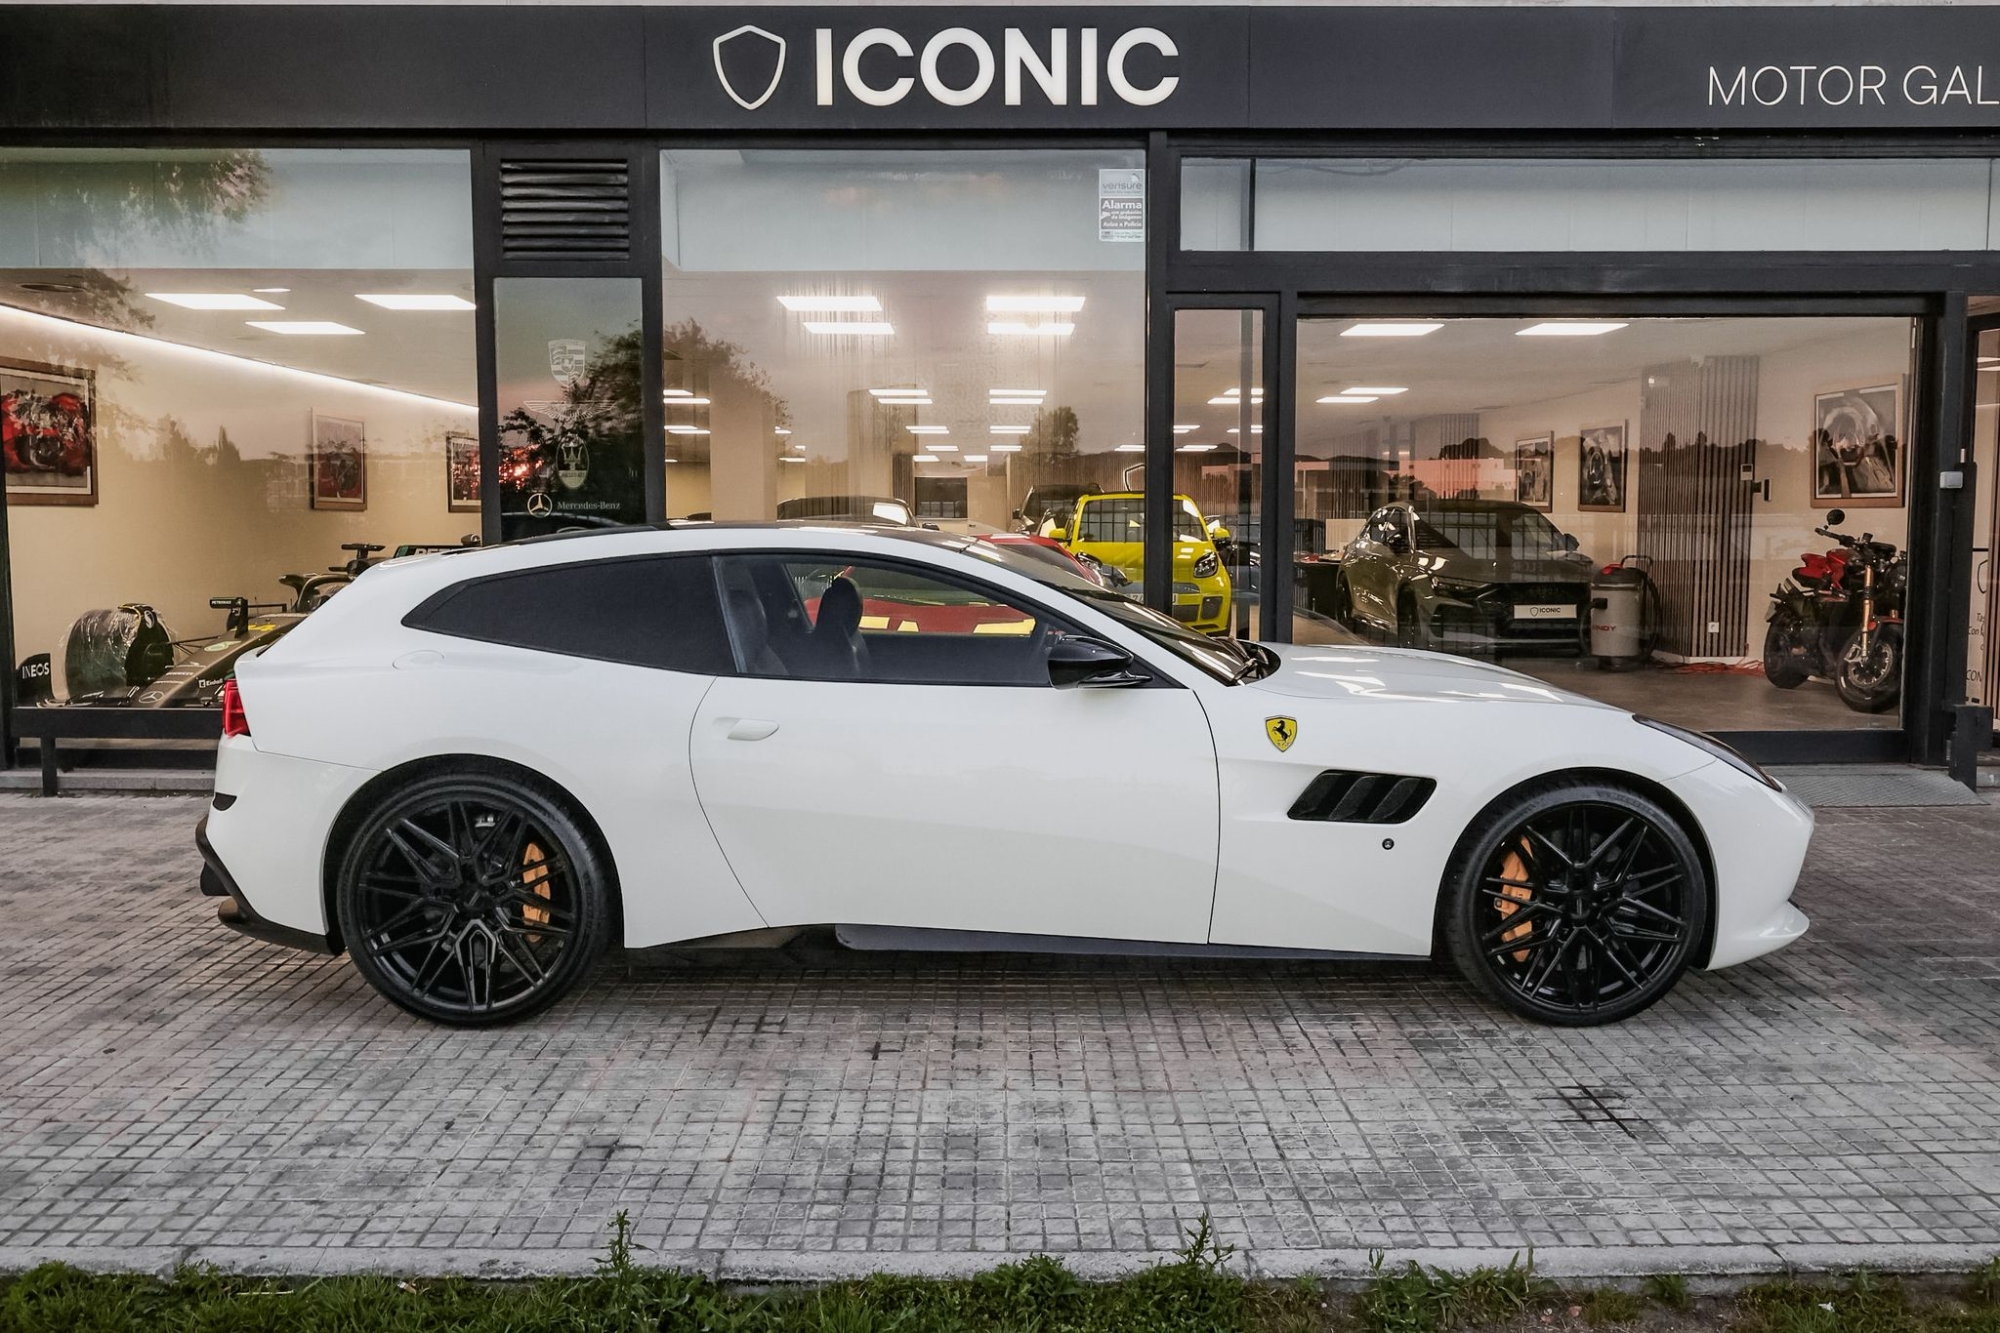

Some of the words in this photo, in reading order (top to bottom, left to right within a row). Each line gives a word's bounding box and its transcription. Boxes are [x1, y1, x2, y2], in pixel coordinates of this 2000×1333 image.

[815, 27, 1180, 106] ICONIC
[1708, 65, 1887, 106] MOTOR
[1902, 65, 2000, 106] GAL
[1102, 200, 1142, 209] Alarma
[557, 501, 621, 510] Mercedes-Benz
[21, 662, 50, 679] INEOS
